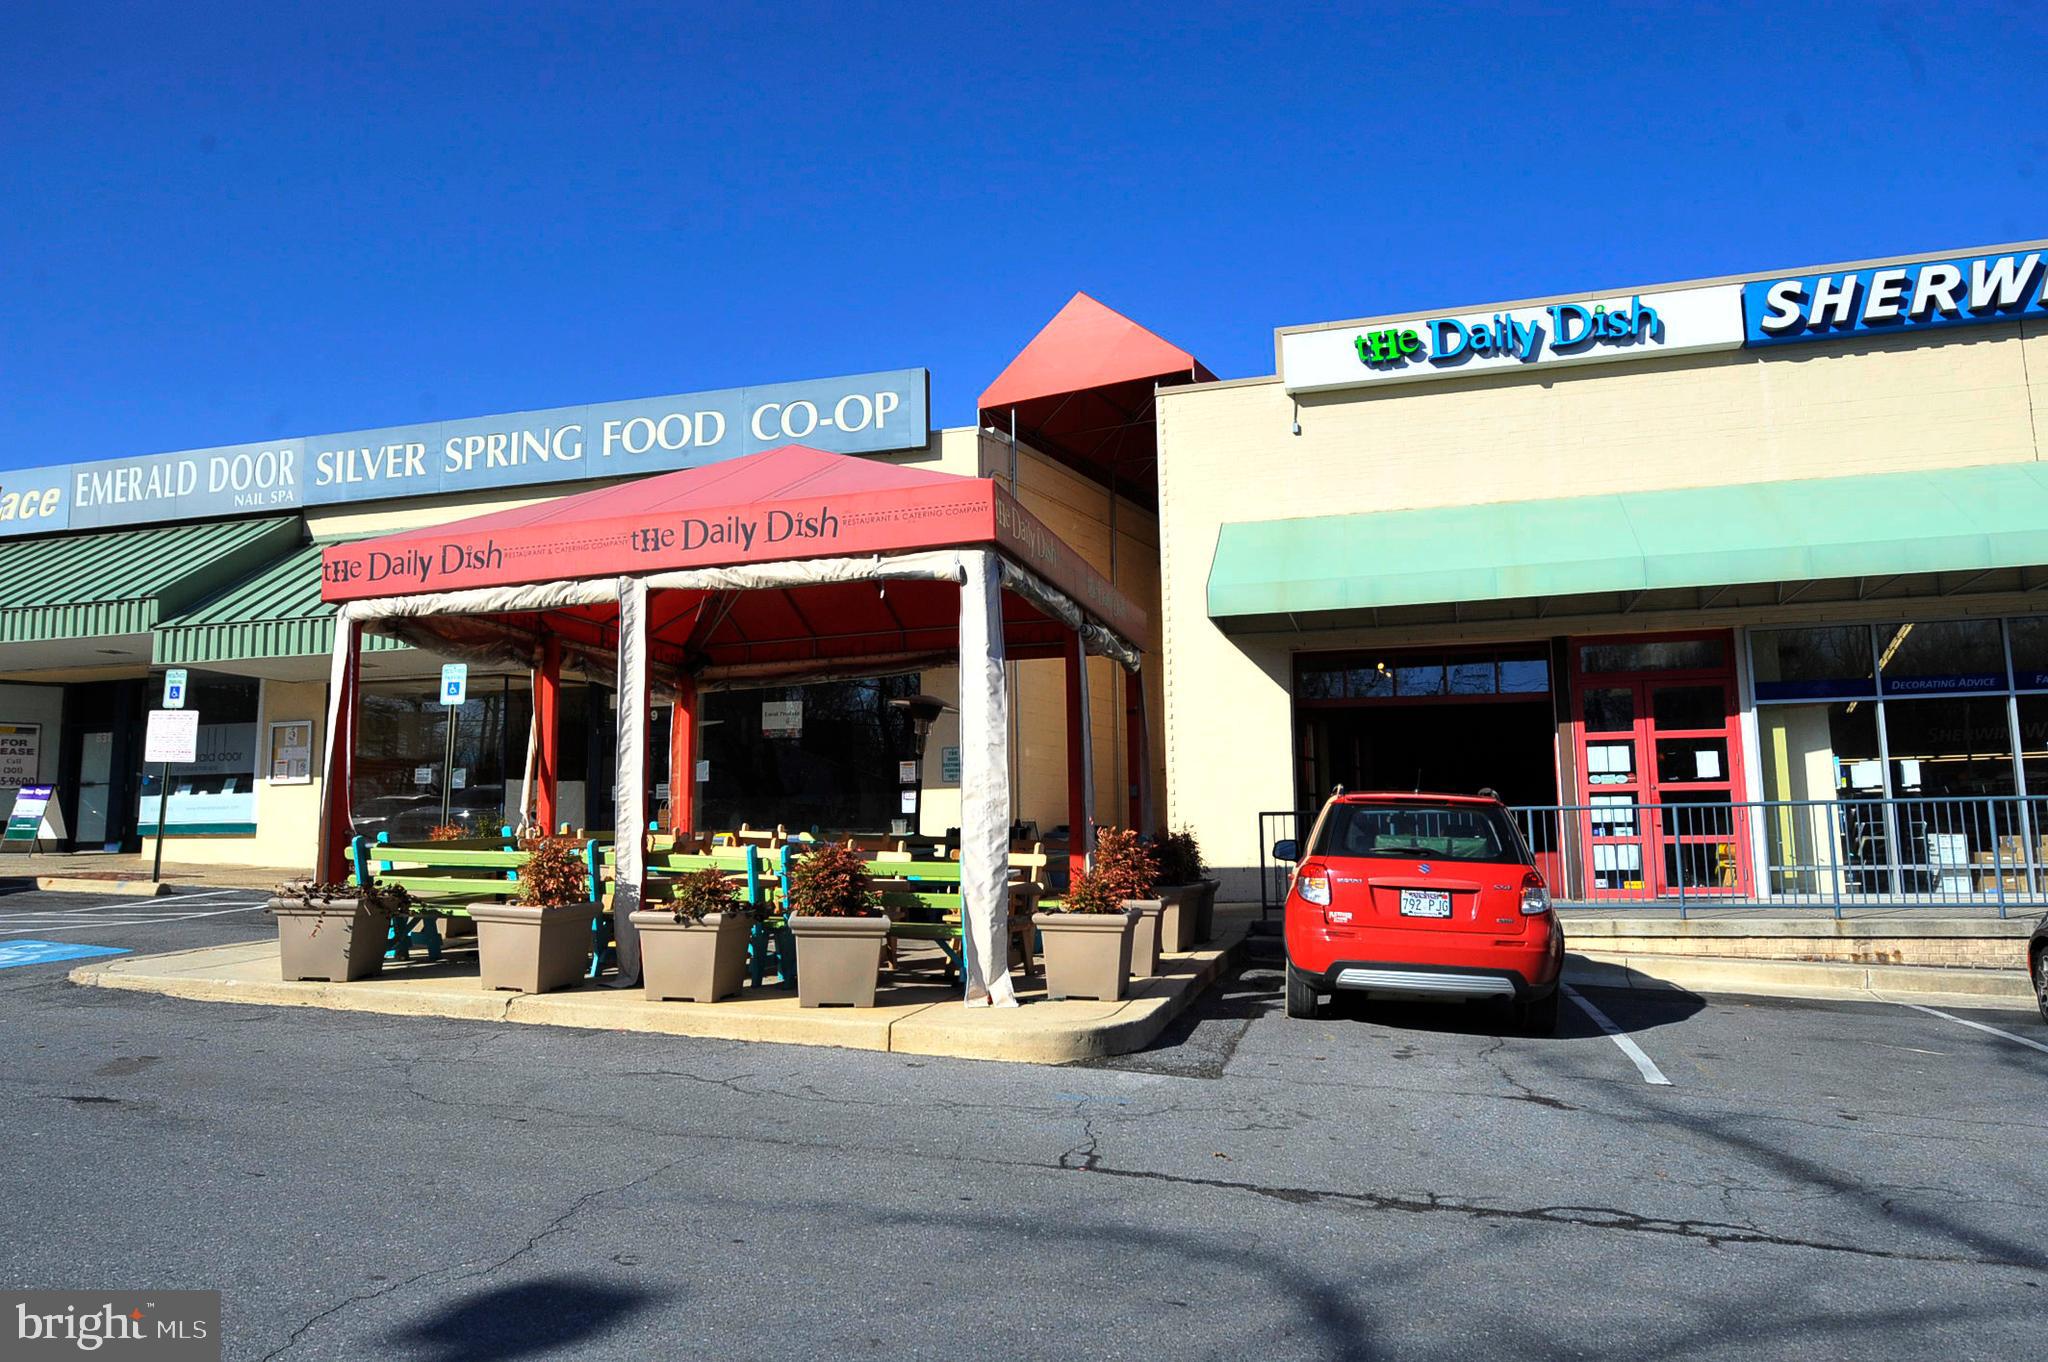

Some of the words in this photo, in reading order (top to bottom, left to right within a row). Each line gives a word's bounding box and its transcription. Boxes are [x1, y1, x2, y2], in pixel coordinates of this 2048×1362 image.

[1761, 254, 2048, 332] SHERW
[1354, 327, 1421, 363] tHe
[1426, 313, 1538, 363] Daily
[1547, 295, 1658, 350] Dish
[315, 443, 426, 486] SILVER
[445, 424, 582, 473] SPRING
[603, 411, 726, 456] FOOD
[751, 391, 899, 441] CO-OP
[76, 459, 197, 508] EMERALD
[208, 449, 295, 491] DOOR
[0, 486, 61, 521] ace
[234, 494, 265, 508] NAIL
[270, 490, 294, 505] SPA
[842, 515, 891, 526] RESTAURANT
[902, 510, 943, 521] CATERING
[945, 505, 989, 516] COMPANY
[681, 514, 757, 551] Daily
[767, 506, 838, 543] Dish
[368, 549, 433, 583] Daily
[440, 540, 503, 575] Dish
[504, 548, 546, 558] RESTAURANT
[554, 543, 590, 554] CATERING
[591, 539, 629, 550] COMPANY
[1892, 679, 1955, 690] DECORATING
[1958, 677, 1996, 688] ADVICE
[1403, 898, 1422, 911] 792
[1429, 899, 1448, 912] PJG
